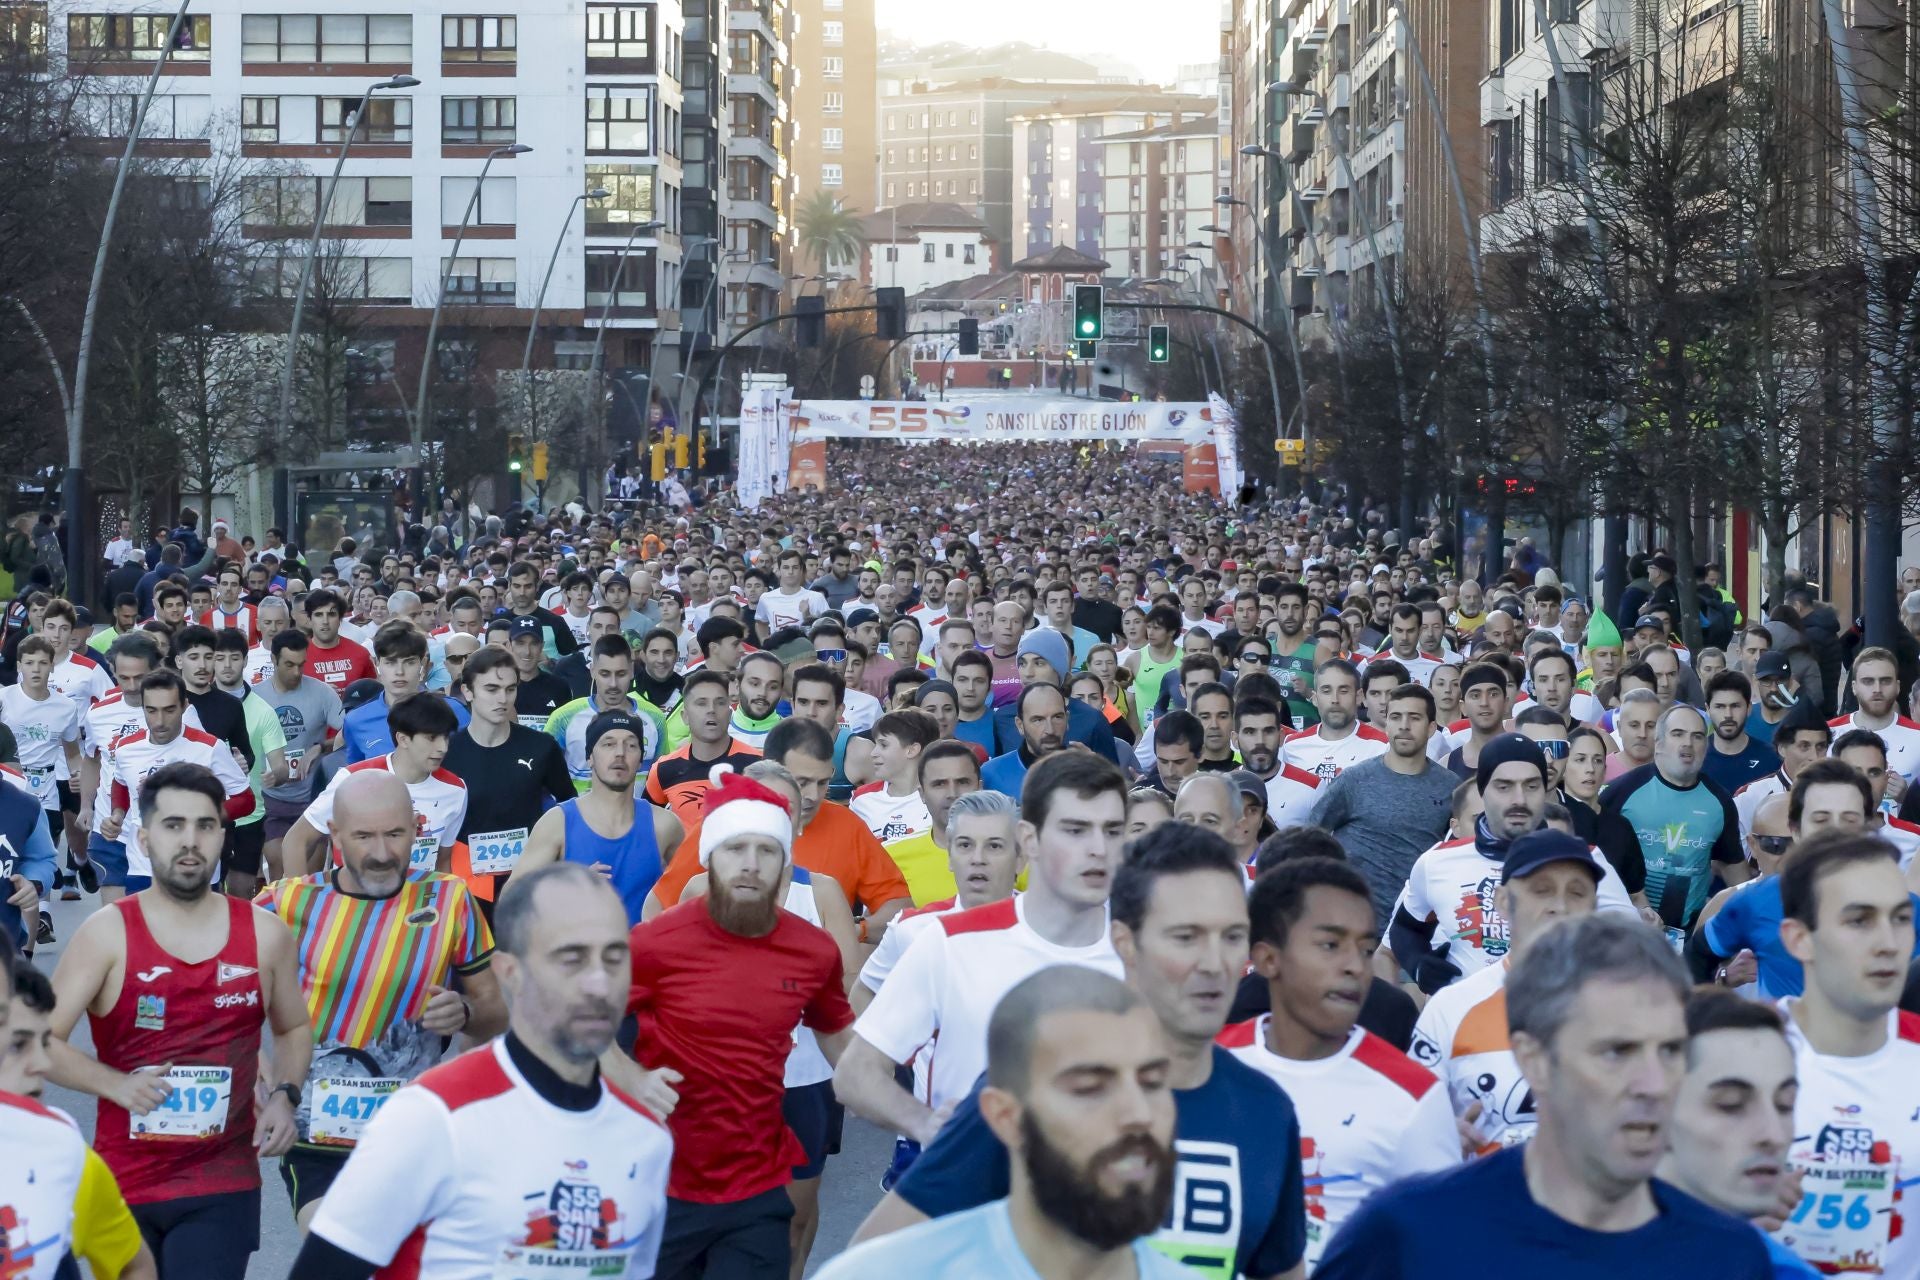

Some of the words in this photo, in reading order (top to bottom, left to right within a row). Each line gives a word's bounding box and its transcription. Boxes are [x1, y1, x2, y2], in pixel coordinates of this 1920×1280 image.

[868, 406, 927, 432] 55
[986, 412, 1098, 431] SANSILVESTRE
[1102, 409, 1146, 431] GIJÓN
[314, 661, 327, 674] SER
[1325, 764, 1336, 772] 55
[894, 824, 907, 833] 55
[476, 841, 523, 861] 2964
[1480, 923, 1511, 941] TRE
[341, 1079, 358, 1088] SAN
[1841, 1130, 1870, 1151] 55
[1826, 1168, 1886, 1180] SILVESTRE
[571, 1185, 600, 1208] 55
[557, 1200, 601, 1231] SAN
[556, 1223, 596, 1251] SIL
[547, 1254, 571, 1267] SAN
[573, 1254, 627, 1268] SILVESTRE
